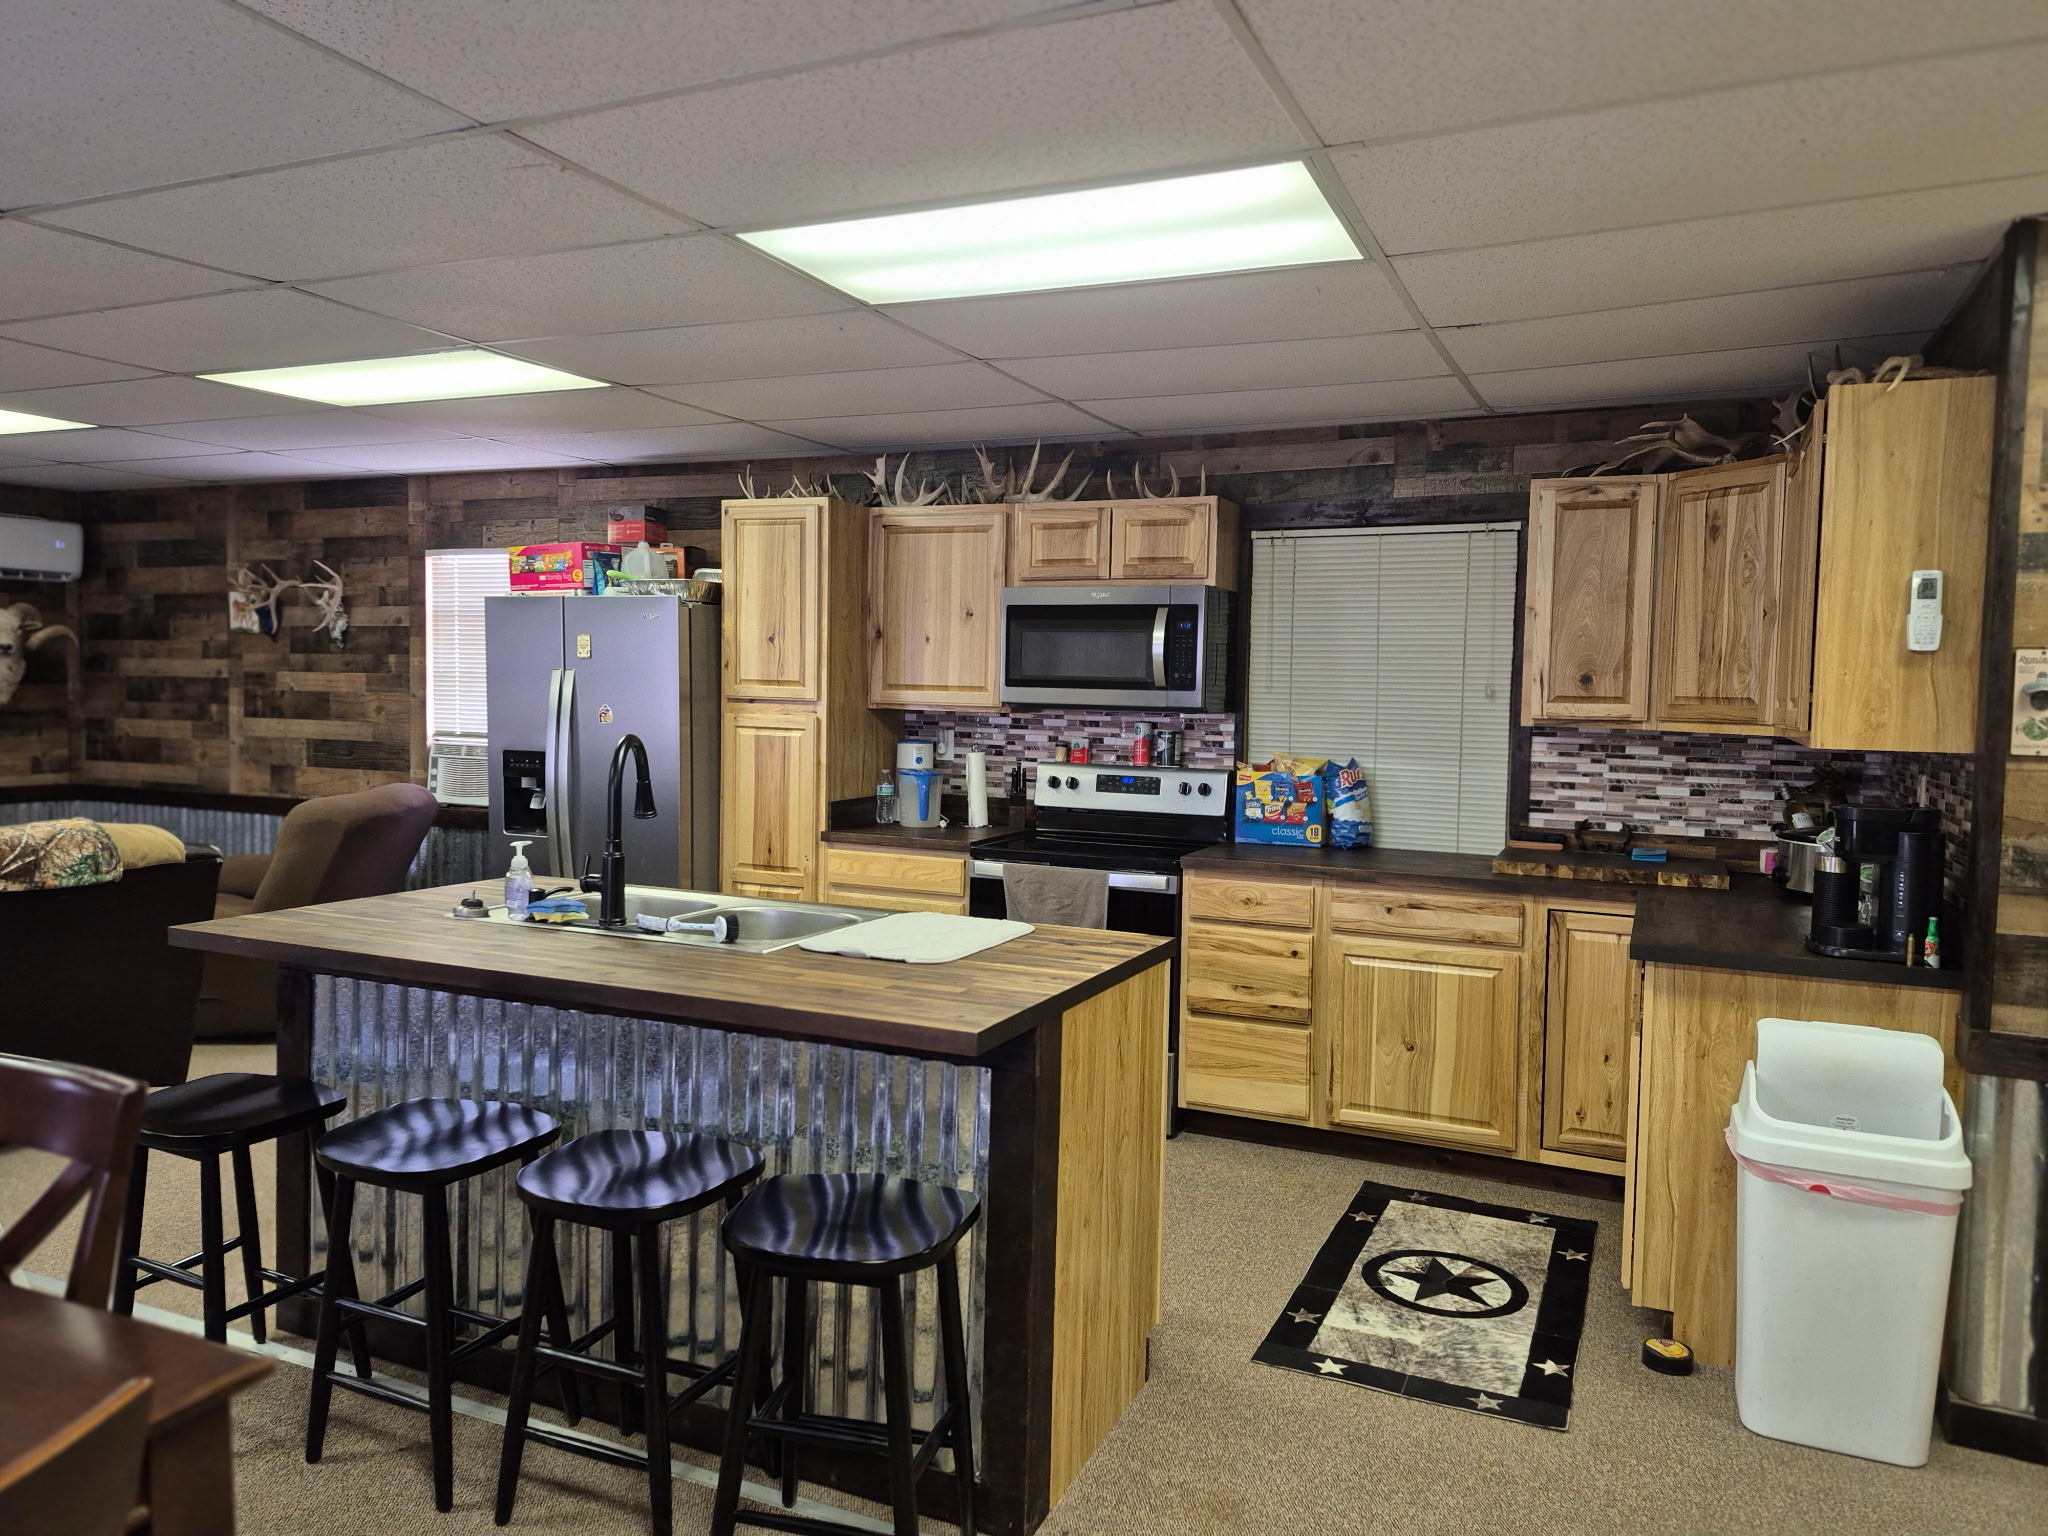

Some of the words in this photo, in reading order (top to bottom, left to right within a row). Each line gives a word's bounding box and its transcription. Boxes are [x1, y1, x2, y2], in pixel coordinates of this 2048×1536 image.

[2018, 655, 2048, 665] Remin
[1271, 826, 1304, 837] classic
[1309, 827, 1320, 837] 18
